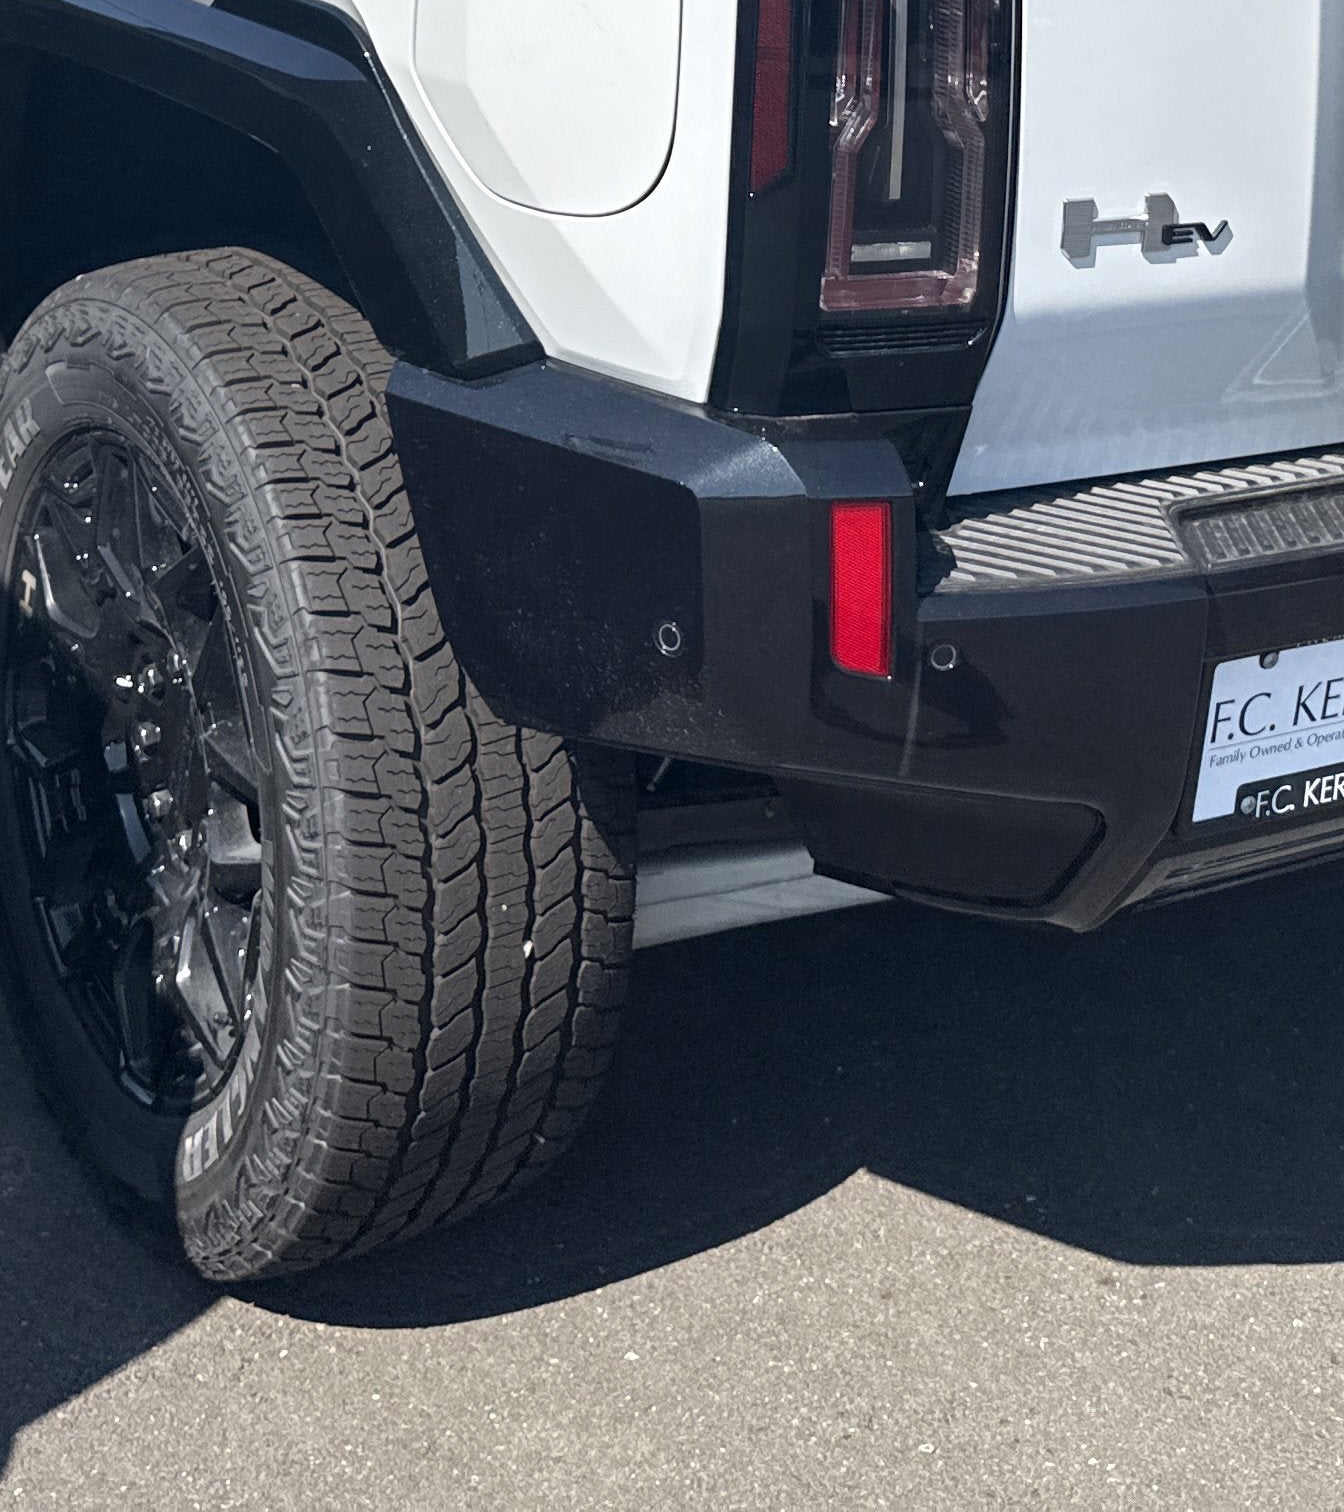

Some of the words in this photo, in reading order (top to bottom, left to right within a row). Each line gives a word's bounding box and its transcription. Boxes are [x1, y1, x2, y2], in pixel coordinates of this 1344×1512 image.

[1209, 691, 1277, 744] F.C.
[1209, 751, 1247, 768] Family
[1249, 742, 1293, 758] Owned
[1294, 737, 1304, 750] &
[1255, 784, 1295, 818] F.C.
